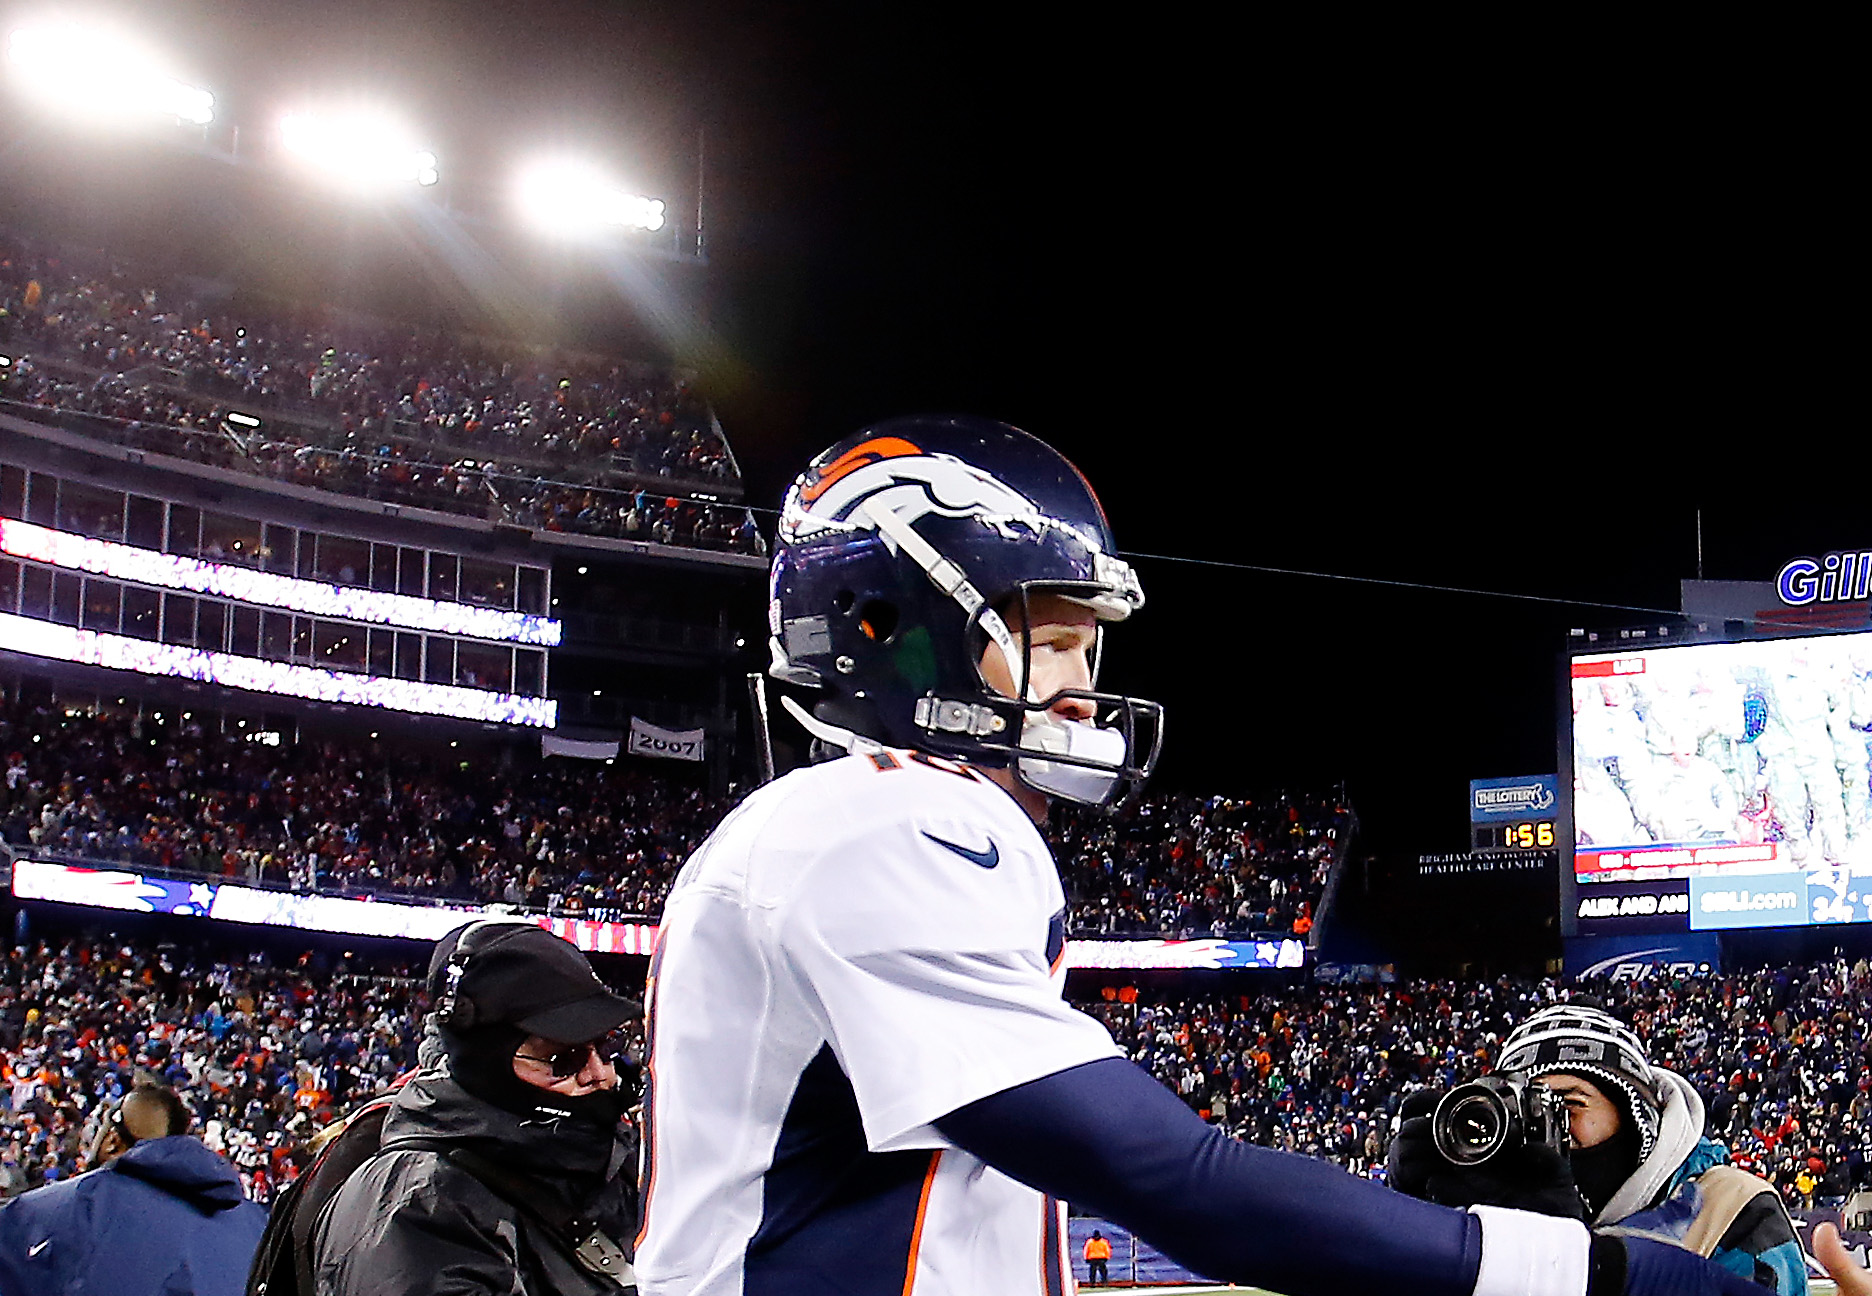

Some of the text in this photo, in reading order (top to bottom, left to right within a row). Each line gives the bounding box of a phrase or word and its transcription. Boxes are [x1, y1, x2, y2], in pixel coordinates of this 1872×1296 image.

[638, 733, 696, 755] 2007
[1479, 789, 1536, 804] THE LOTTERY
[1505, 823, 1554, 848] 1:56
[1578, 897, 1619, 918] ALEX
[1620, 895, 1658, 916] AND
